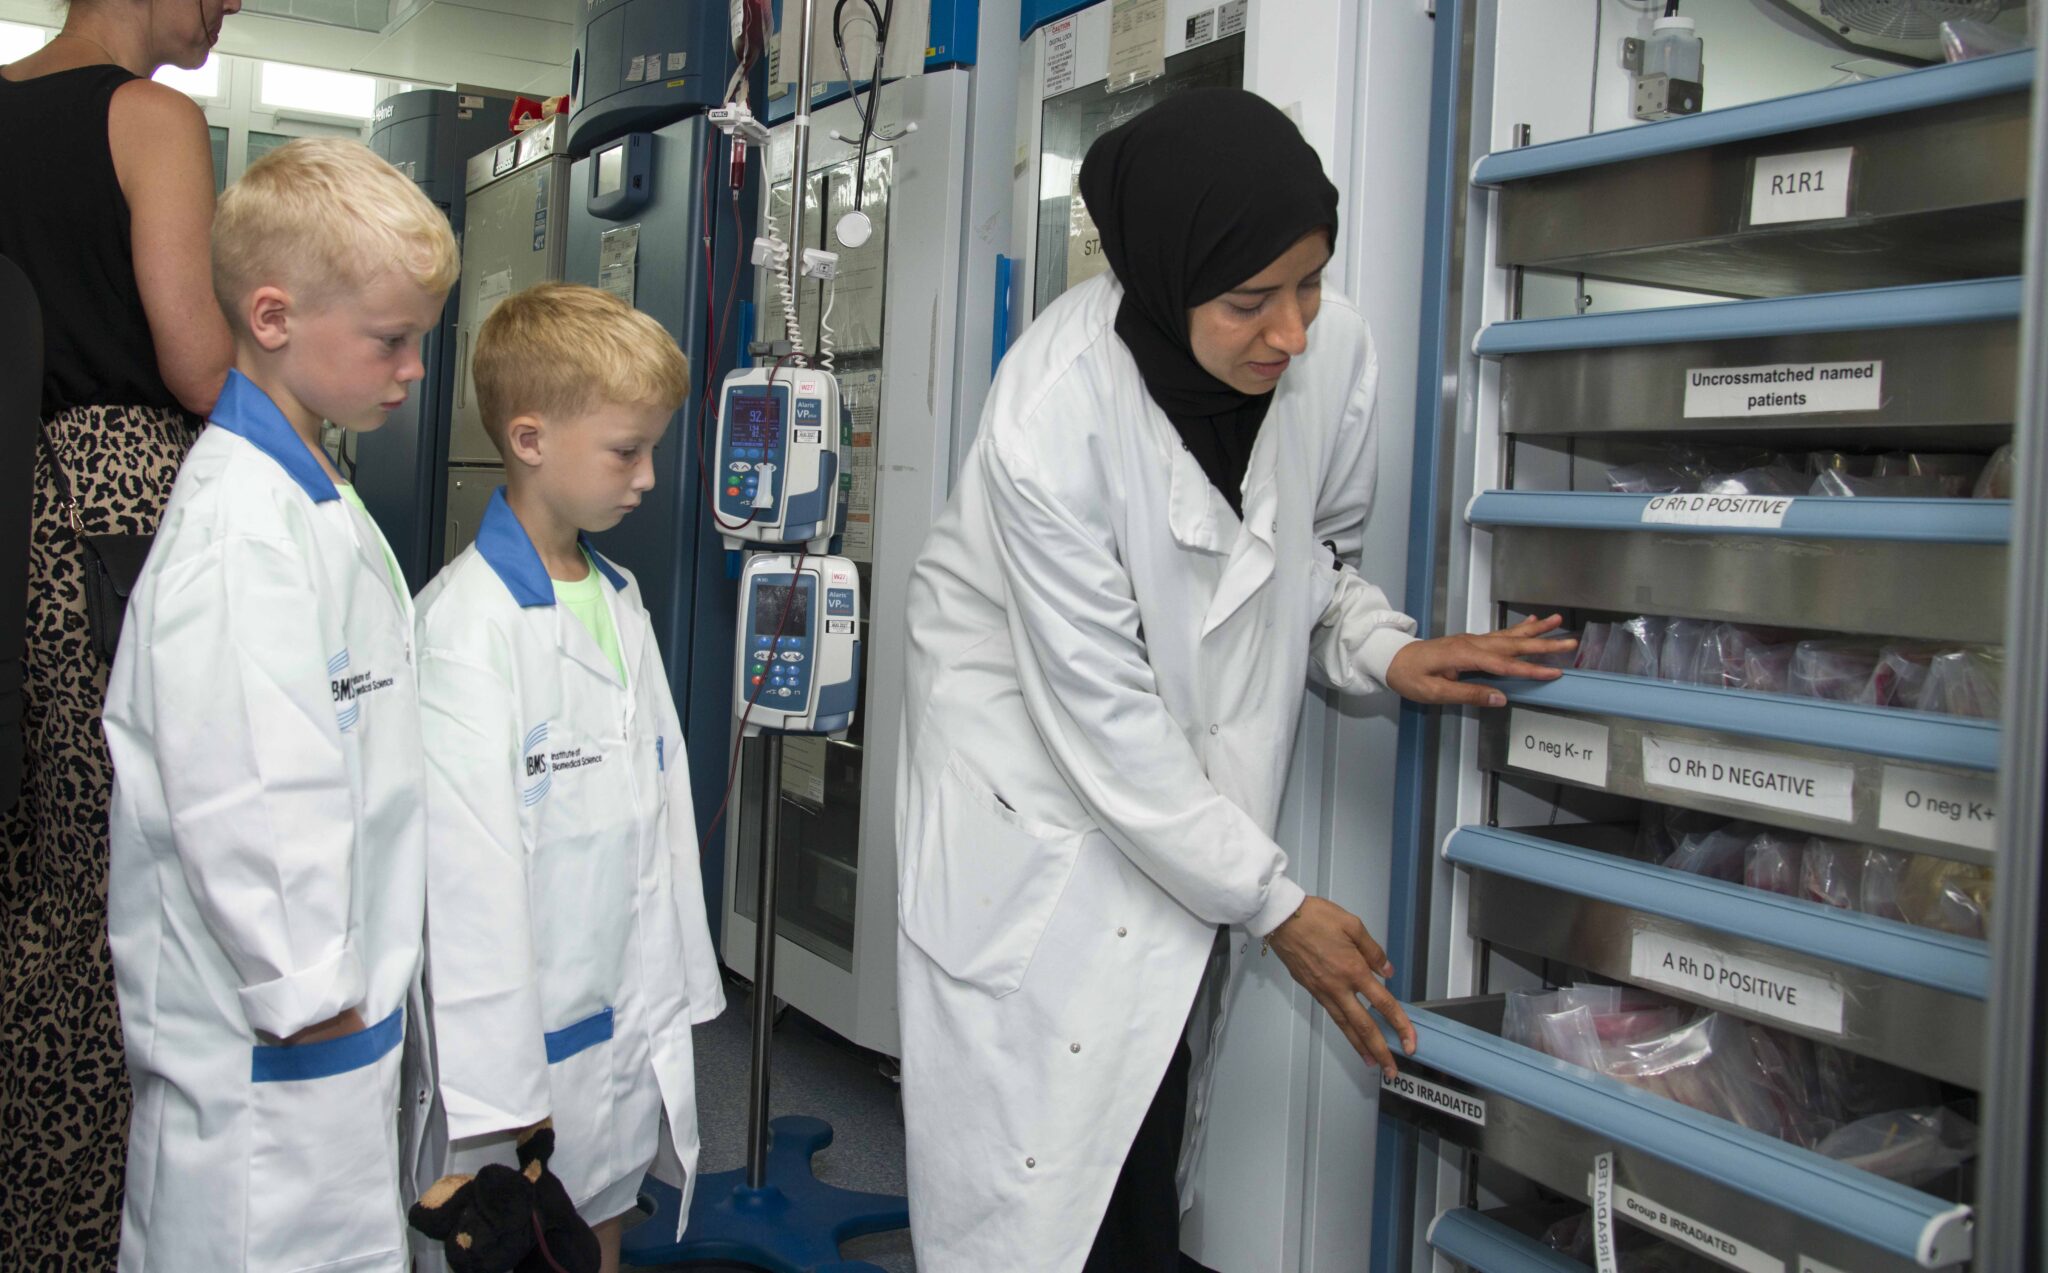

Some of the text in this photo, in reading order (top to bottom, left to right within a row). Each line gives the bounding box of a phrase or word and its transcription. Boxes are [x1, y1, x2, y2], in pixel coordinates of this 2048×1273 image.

[1771, 170, 1825, 195] R1R1
[1692, 364, 1875, 387] Uncrossmatched named
[1748, 392, 1807, 411] patients
[1650, 497, 1787, 514] O Rh D POSITIVE
[372, 678, 394, 690] Science
[551, 750, 575, 761] Institute
[1525, 735, 1593, 760] O neg K- rr
[526, 753, 546, 777] IBMS
[552, 754, 602, 772] Biomedical Science
[1669, 757, 1816, 797] O Rh D NEGATIVE
[1905, 790, 1995, 821] O neg K+
[1662, 952, 1797, 1005] A Rh D POSITIVE
[1394, 1077, 1415, 1095] POS
[1417, 1084, 1483, 1119] IRRADIATED
[1626, 1198, 1738, 1257] Group B IRRADIATED
